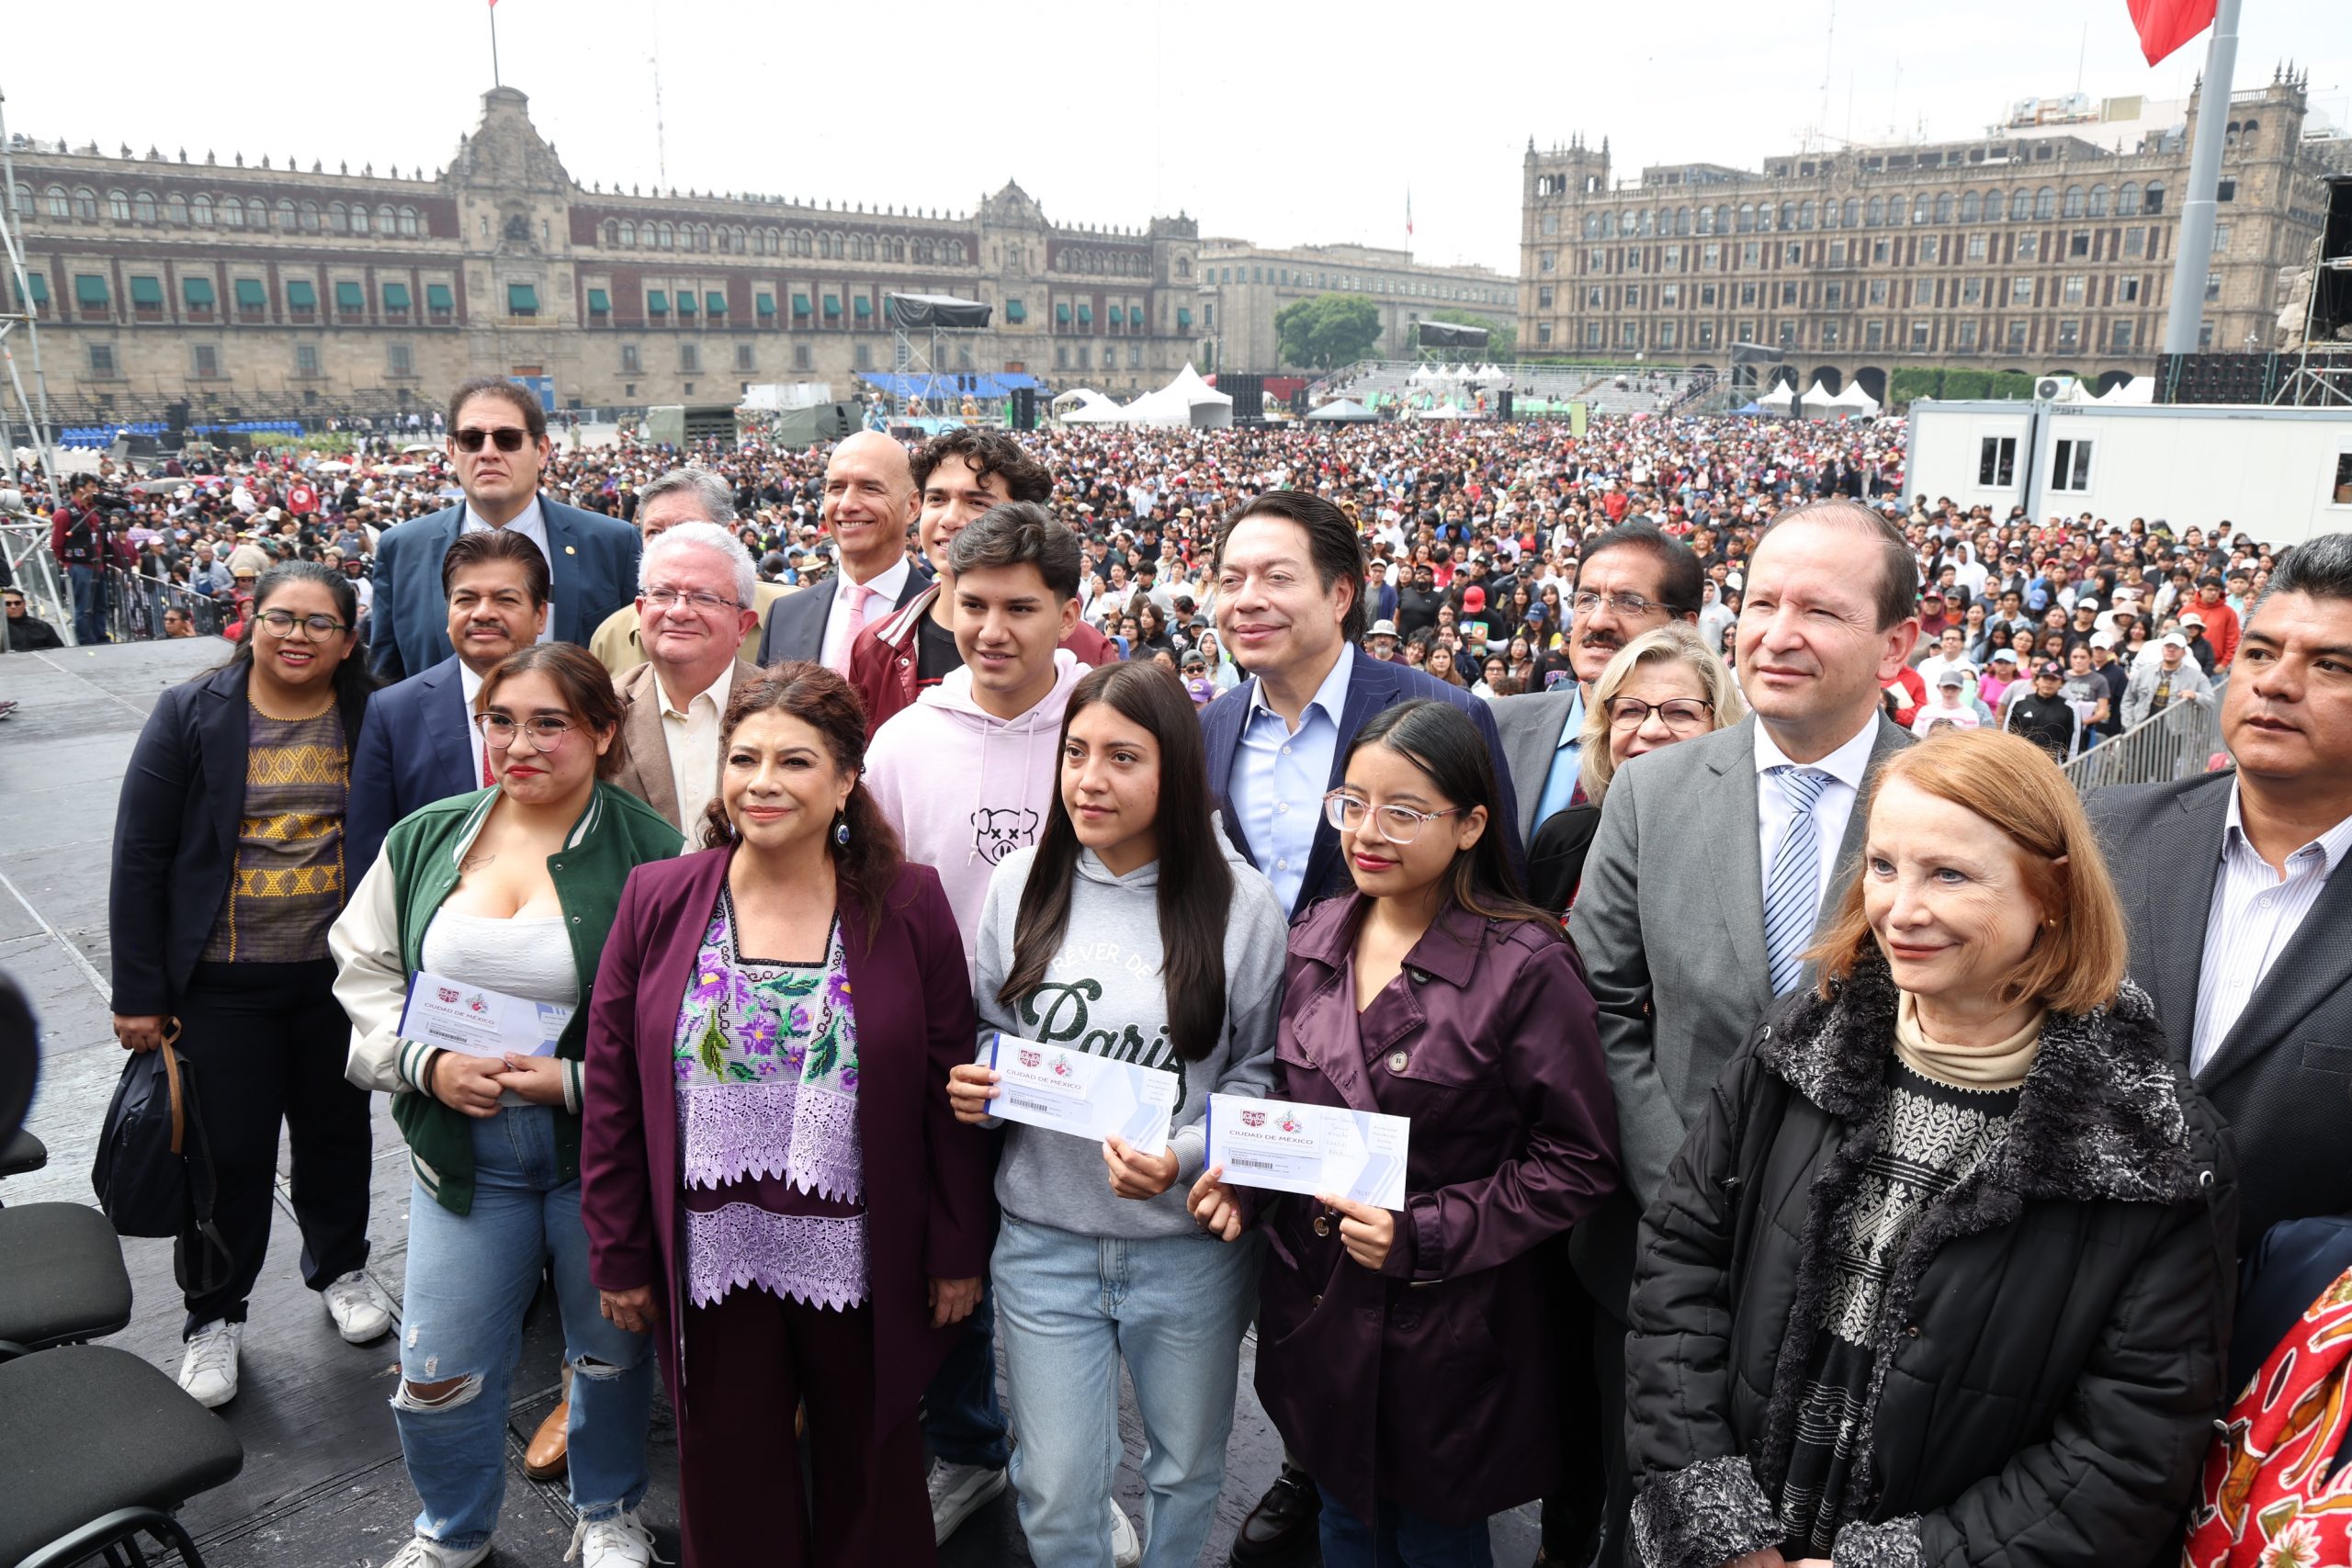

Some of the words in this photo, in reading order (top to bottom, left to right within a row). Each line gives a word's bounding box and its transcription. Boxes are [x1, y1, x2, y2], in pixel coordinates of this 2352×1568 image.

[1125, 953, 1153, 981] DE
[424, 1002, 453, 1014] CIUDAD
[1006, 1069, 1036, 1080] CIUDAD
[1229, 1130, 1263, 1139] CIUDAD
